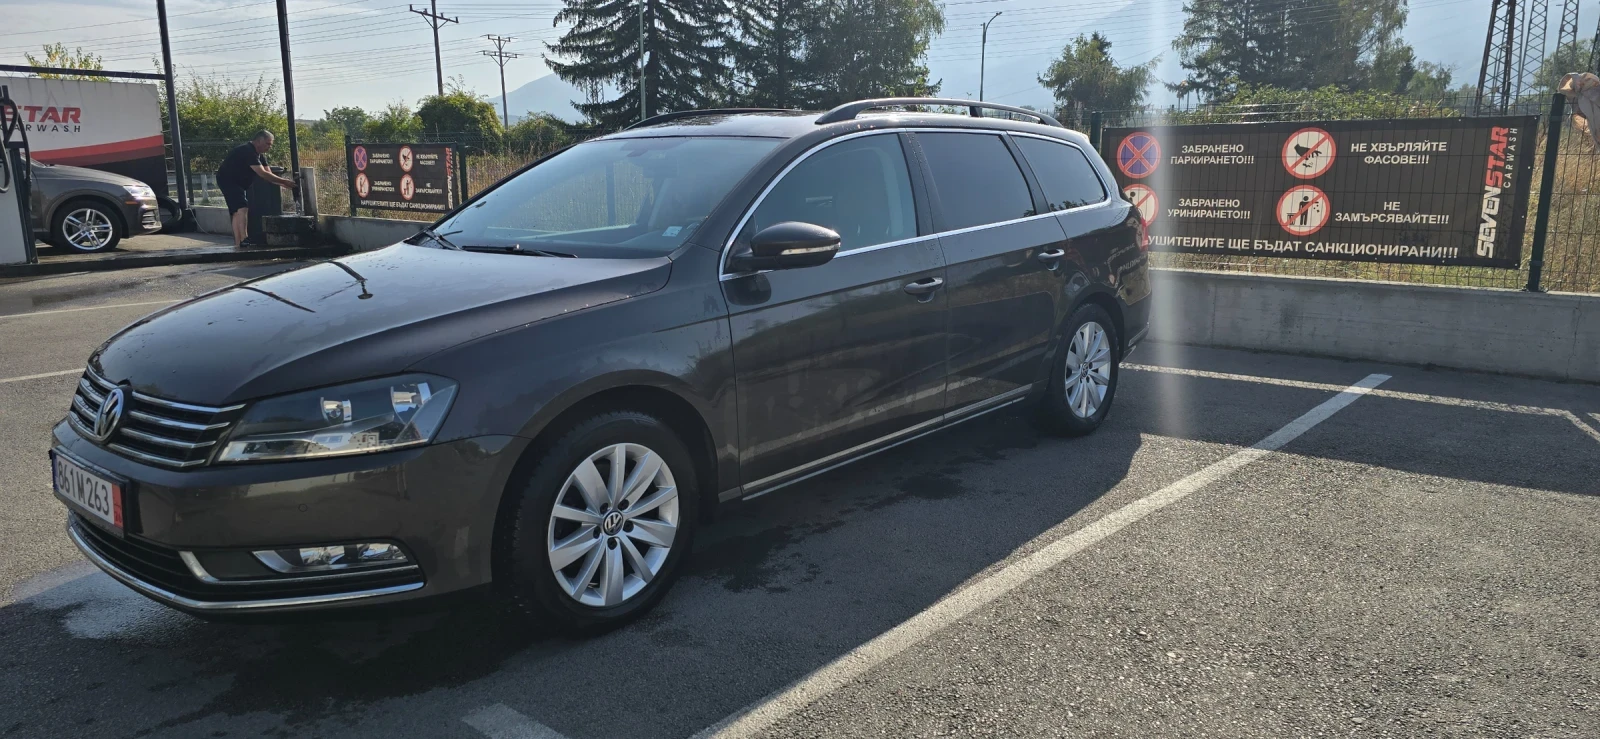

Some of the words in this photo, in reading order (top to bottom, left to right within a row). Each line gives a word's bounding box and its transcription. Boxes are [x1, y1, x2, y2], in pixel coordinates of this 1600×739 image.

[0, 124, 80, 132] ARWASH
[1182, 144, 1244, 154] ЗАБРАНЕНО
[1350, 143, 1367, 152] НЕ
[1370, 140, 1448, 152] ХВЪРЛЯЙТЕ
[1170, 155, 1254, 164] ПАРКИРАНЕТО!!!
[1364, 154, 1430, 164] ФАСОВЕ!!!
[1503, 128, 1518, 188] CARWASH
[1178, 198, 1240, 208] ЗАБРАНЕНО
[1384, 202, 1400, 210] НЕ
[1168, 210, 1250, 219] УРИНИРАНЕТО!!!
[1335, 212, 1450, 224] ЗАМЪРСЯВАЙТЕ!!!
[1228, 239, 1250, 251] ЩЕ
[1254, 240, 1302, 253] БЪДАТ
[1305, 242, 1458, 258] САНКЦИОНИРАНИ!!!
